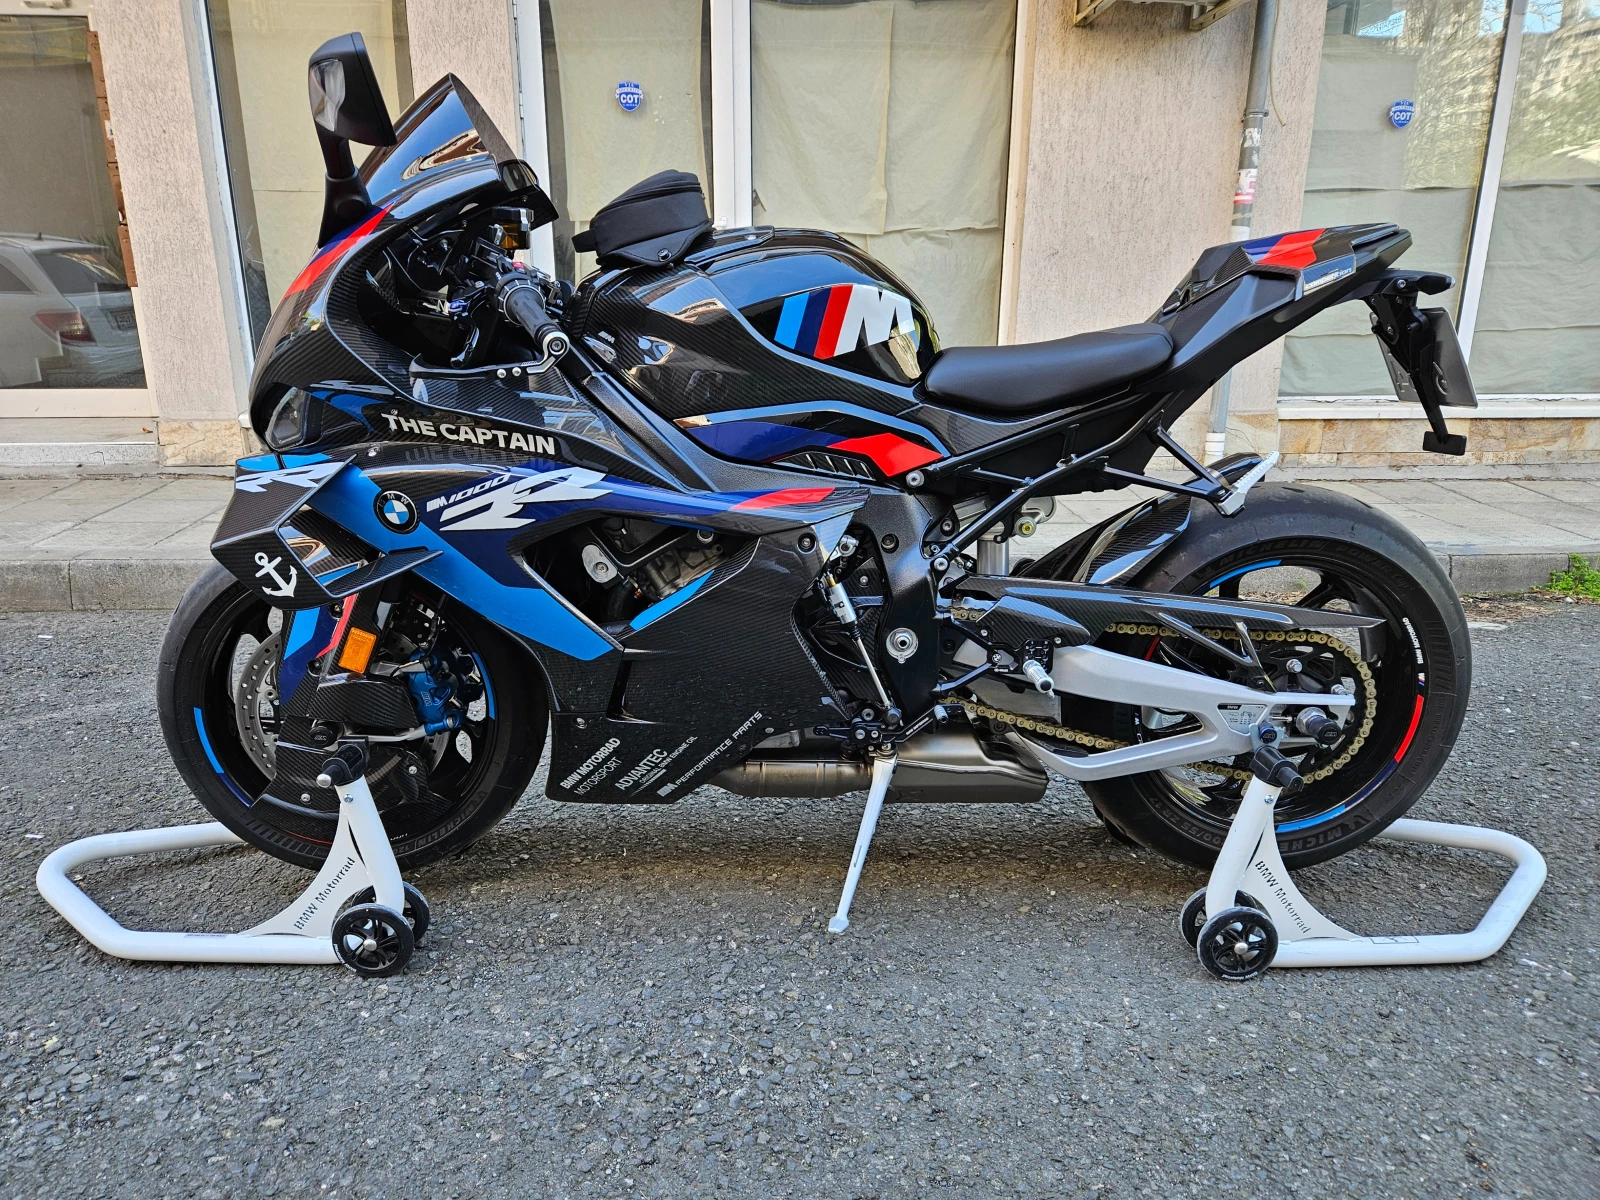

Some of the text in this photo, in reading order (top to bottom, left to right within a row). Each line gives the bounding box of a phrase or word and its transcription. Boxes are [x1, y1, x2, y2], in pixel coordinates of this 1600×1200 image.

[381, 412, 556, 456] THE CAPTAIN
[560, 738, 621, 789] BMW MOTORRAD
[669, 742, 689, 758] ENGINE
[686, 736, 698, 744] OIL
[675, 738, 733, 786] PERFORMANCE
[732, 711, 763, 739] PARTS
[574, 756, 622, 795] MOTORSPORT
[615, 749, 667, 790] ADVANTEC
[1181, 821, 1224, 846] 00/55
[1277, 829, 1343, 851] MICHE
[294, 856, 356, 930] BMW Motorrad
[1255, 861, 1312, 934] BMW Motorrad
